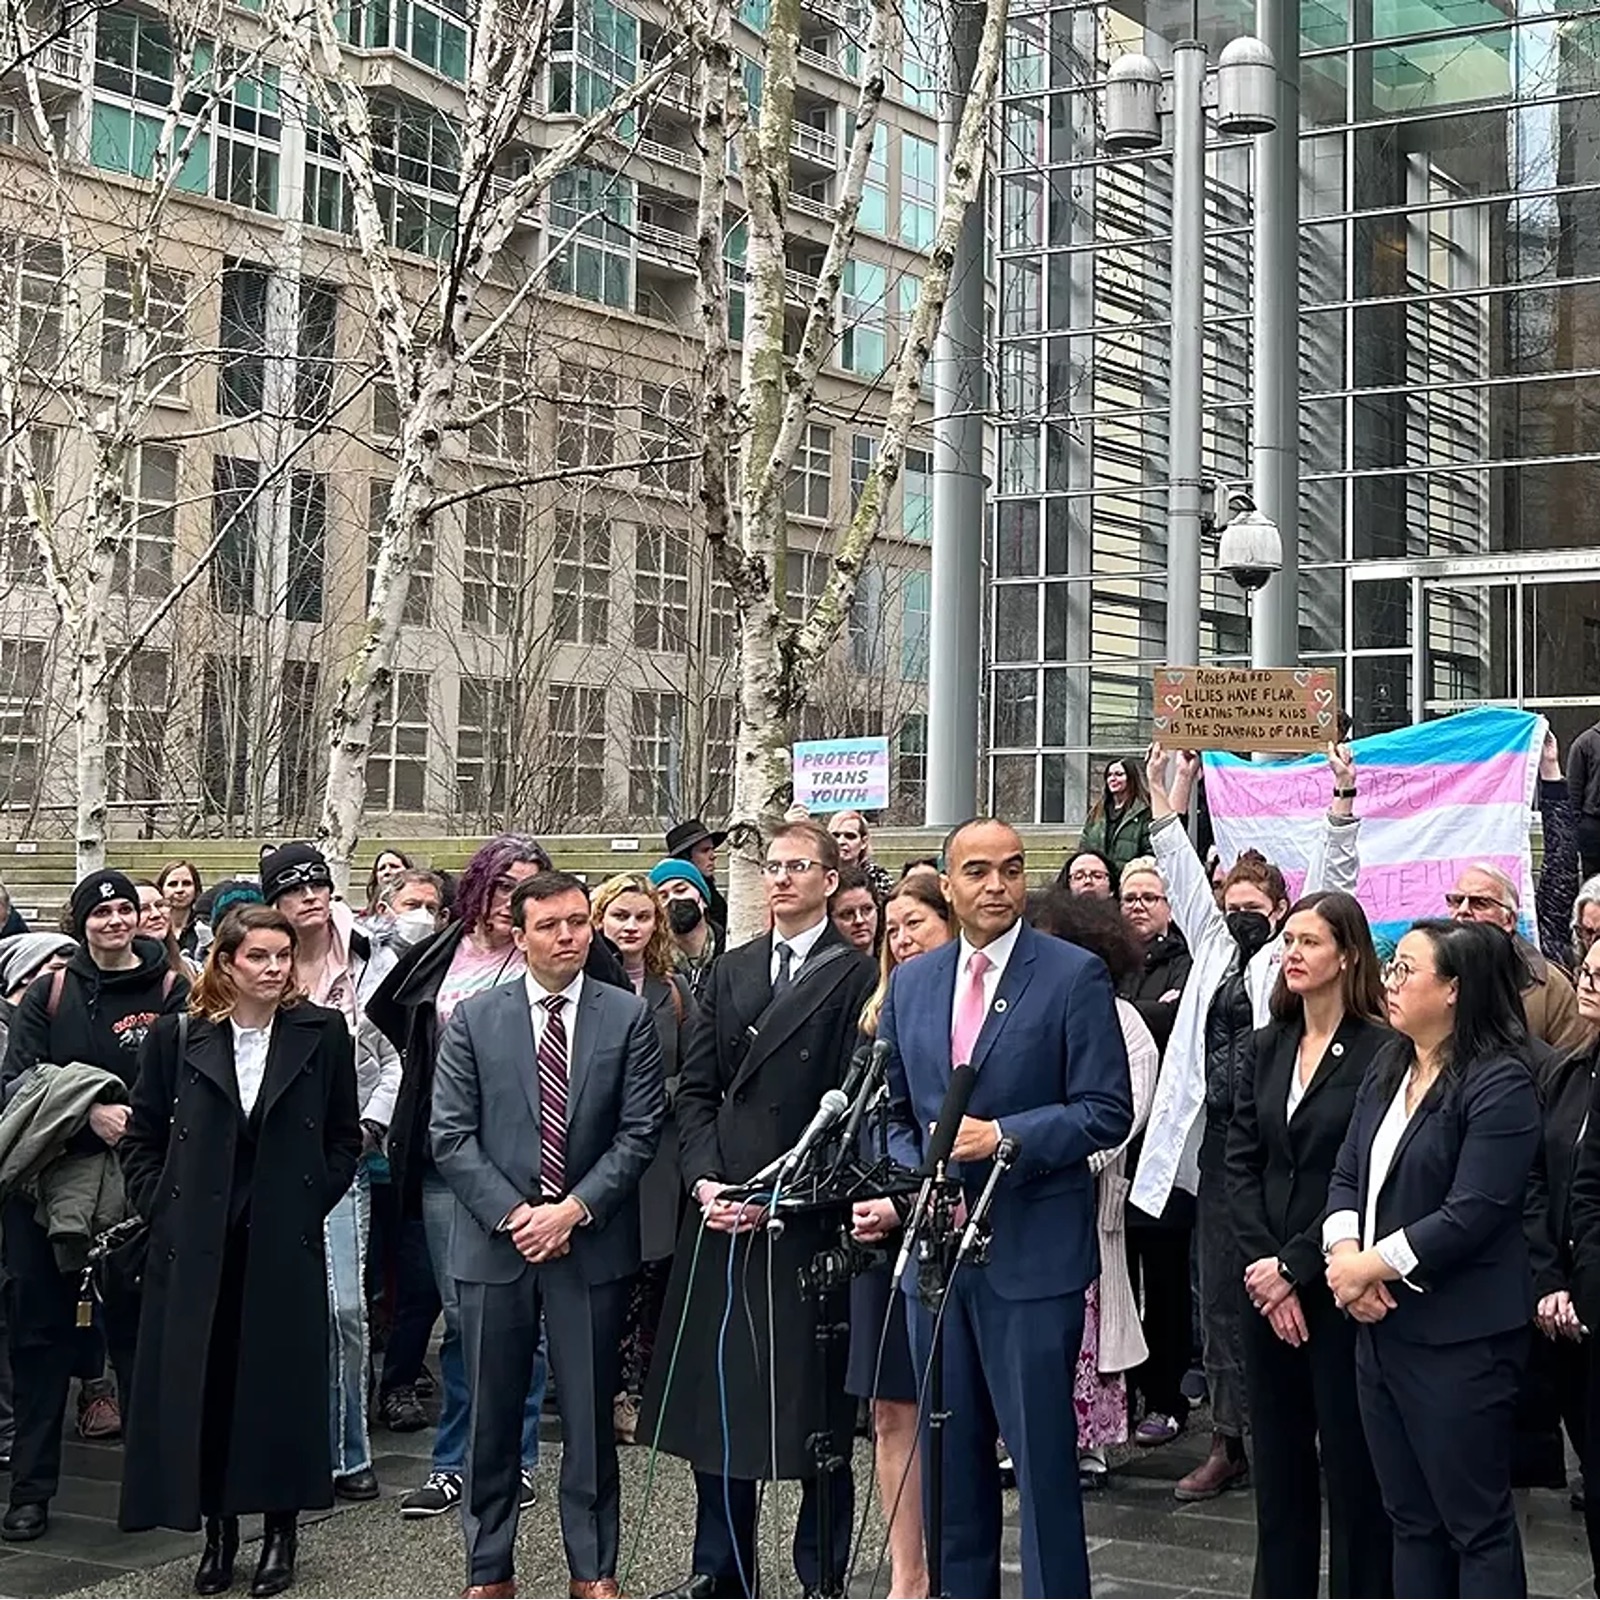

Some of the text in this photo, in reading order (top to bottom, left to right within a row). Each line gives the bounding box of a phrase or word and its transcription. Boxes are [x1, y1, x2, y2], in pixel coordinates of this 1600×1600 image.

[1196, 669, 1226, 685] ROSES
[1229, 670, 1247, 684] ARE
[1185, 688, 1224, 702] LILIES
[1227, 687, 1258, 702] HAVE
[1180, 704, 1307, 721] TREATING TRANS KIDS
[1170, 722, 1180, 735] IS
[1185, 722, 1208, 737] THE
[1269, 725, 1286, 738] OF
[1286, 724, 1321, 740] CARE
[802, 750, 880, 768] PROTECT
[811, 770, 869, 785] TRANS
[811, 788, 869, 804] YOUTH
